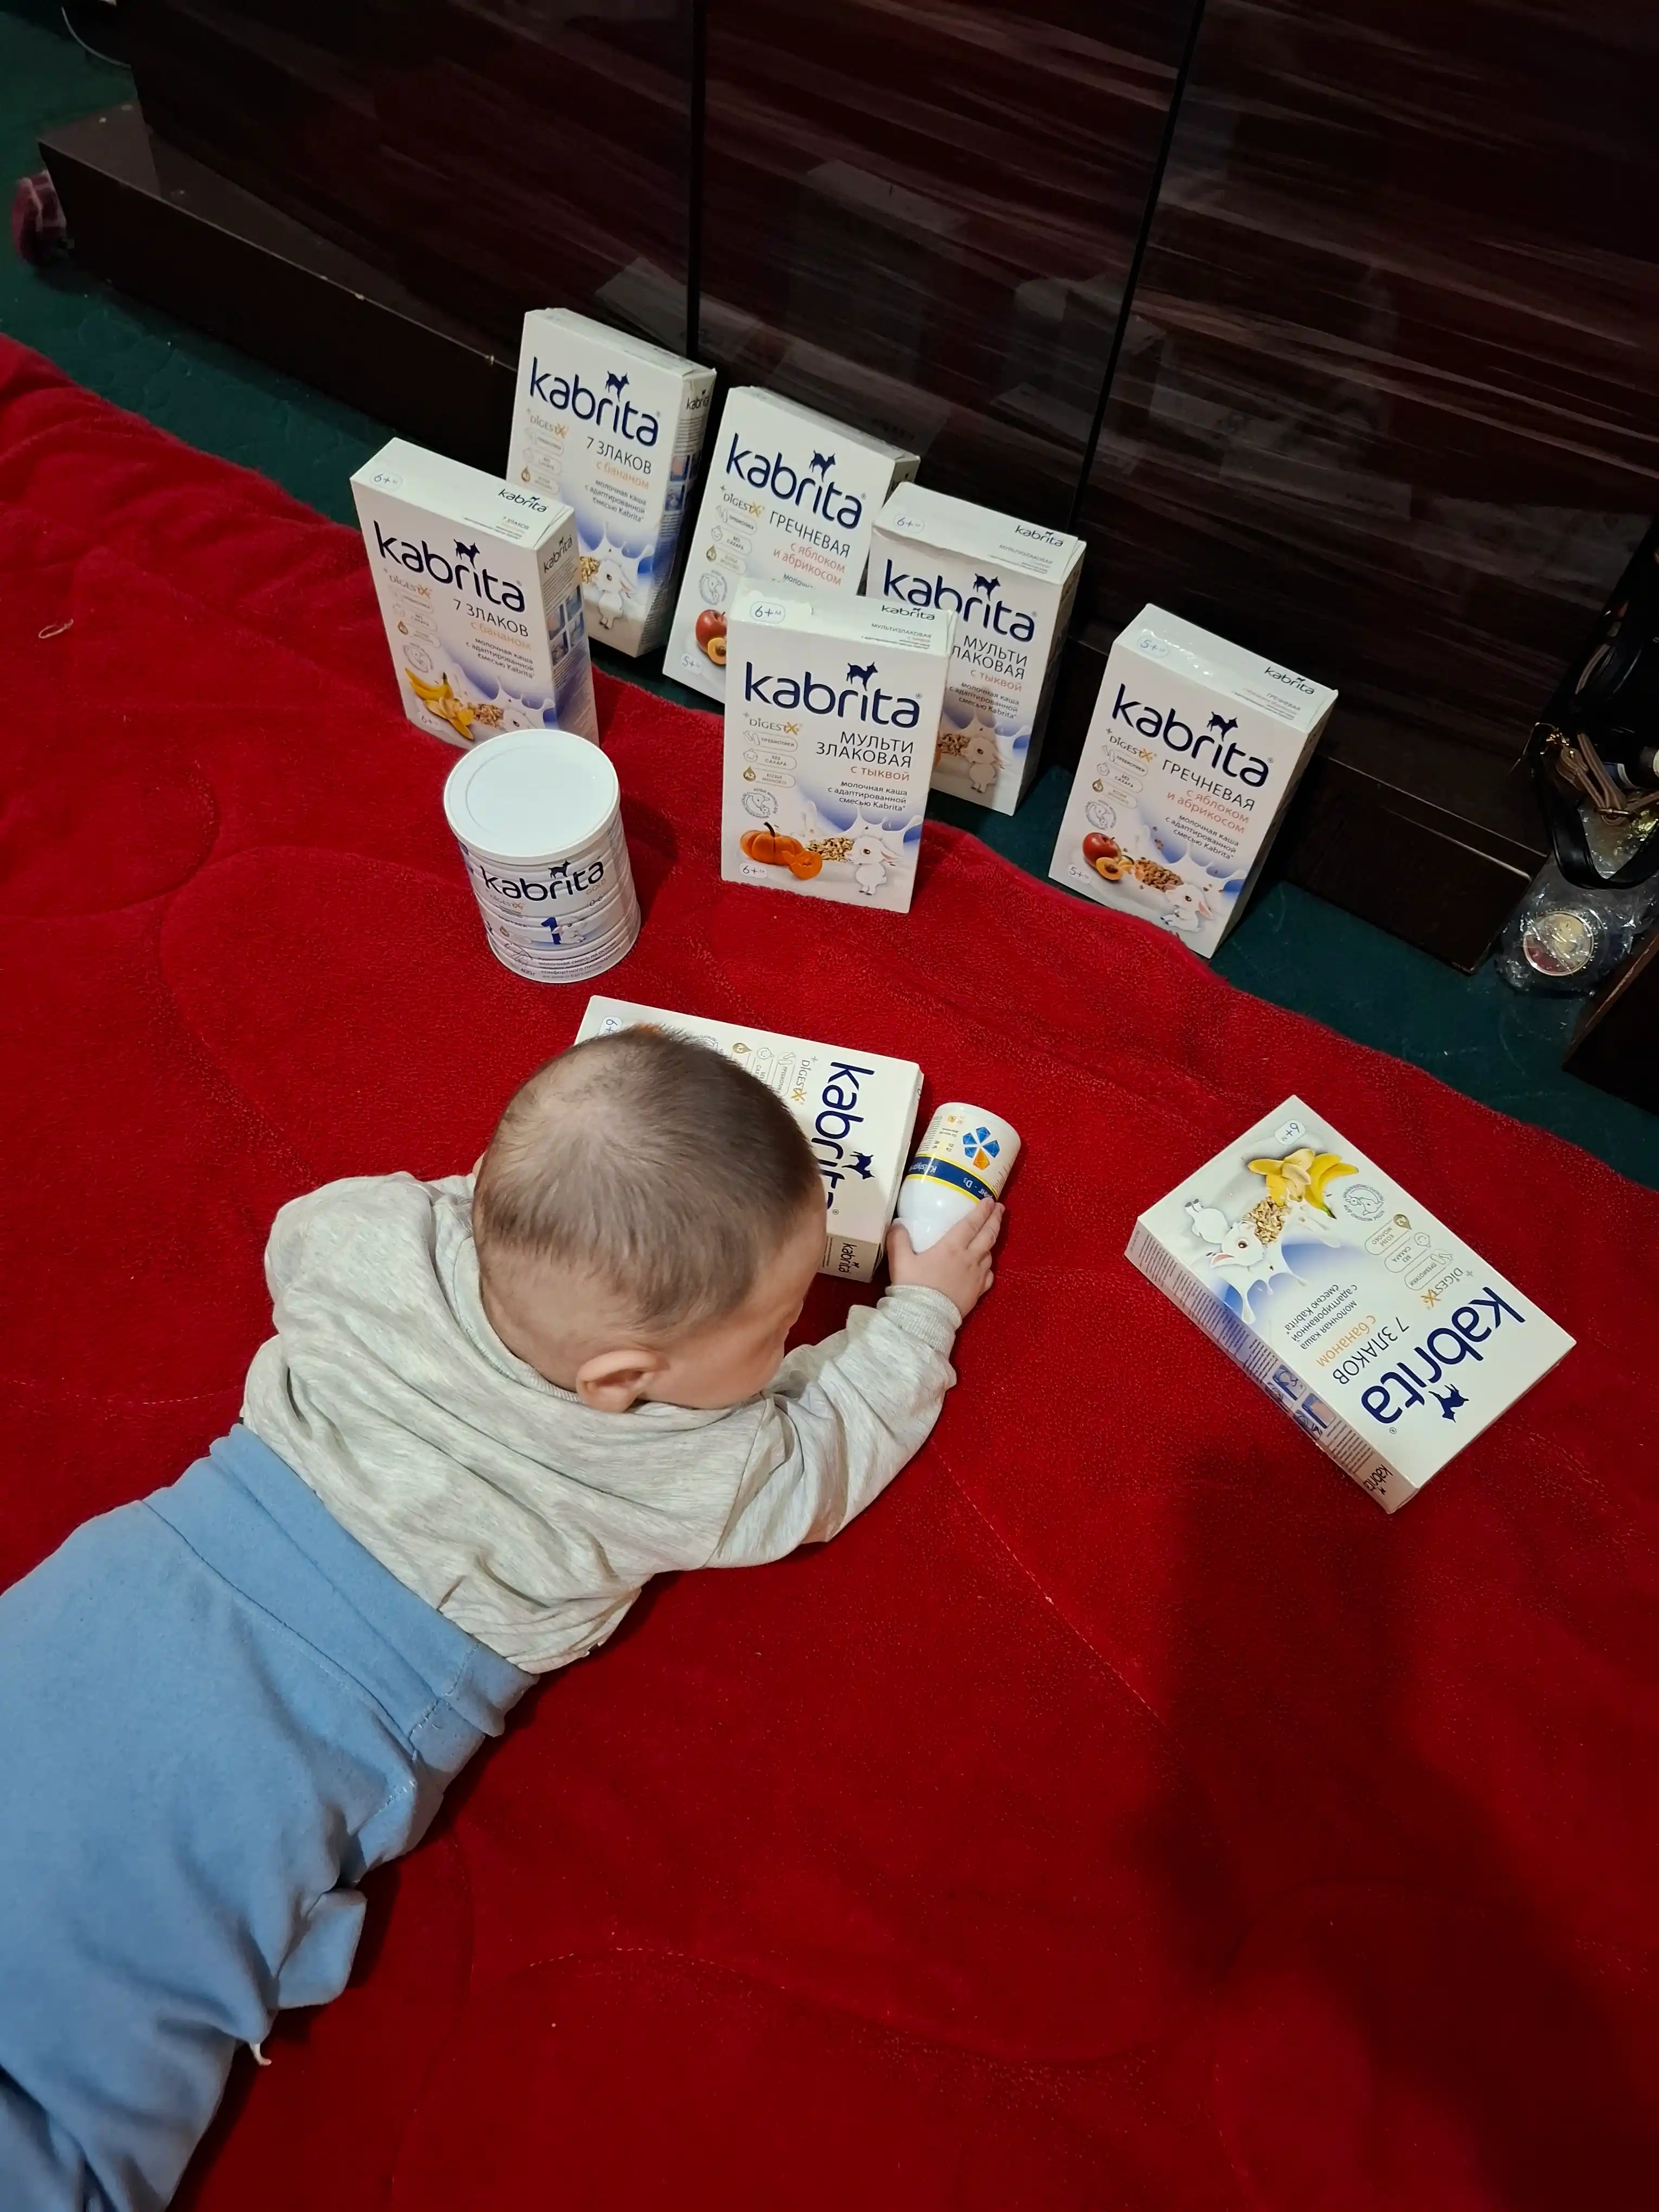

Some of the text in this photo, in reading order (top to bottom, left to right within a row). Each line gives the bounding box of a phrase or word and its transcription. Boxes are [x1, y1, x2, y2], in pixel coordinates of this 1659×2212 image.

[530, 356, 658, 446] kabrita
[587, 436, 594, 449] 7
[596, 441, 652, 474] ЗЛАКОВ
[604, 461, 650, 489] бананом
[726, 433, 862, 529] kabrita
[498, 488, 548, 513] kabrita
[769, 511, 851, 558] ГРЕЧНЕВАЯ
[1015, 525, 1063, 546] kabrita
[374, 520, 525, 613] kabrita
[543, 537, 573, 573] kabrita
[773, 549, 842, 587] и абрикосом
[798, 544, 846, 574] яблоком
[882, 605, 935, 621] kabrita
[884, 558, 1035, 642] kabrita
[453, 599, 461, 610] 7
[466, 603, 529, 637] ЗЛАКОВ
[480, 623, 531, 651] бананом
[963, 635, 1027, 667] МУЛЬТИ
[952, 645, 1025, 680] ЛАКОВАЯ
[745, 661, 920, 728] kabrita
[1264, 666, 1315, 695] kabrita
[840, 731, 914, 754] МУЛЬТИ
[1112, 683, 1269, 787] kabrita
[815, 742, 912, 768] ЗЛАКОВАЯ
[840, 781, 908, 796] молочная каша
[860, 767, 910, 781] тыквой
[1162, 759, 1256, 812] ГРЕЧНЕВАЯ
[834, 788, 906, 804] адаптированной
[839, 797, 871, 807] смесью
[1195, 794, 1250, 824] яблоком
[1167, 792, 1245, 834] и абрикосом
[1171, 820, 1237, 853] адаптированной
[1173, 829, 1203, 846] смесью
[1179, 815, 1239, 846] молочная каша
[480, 861, 604, 901] kabrita
[541, 917, 562, 945] 1
[811, 1062, 875, 1210] kabrit
[838, 1243, 857, 1274] kabrita
[1391, 1246, 1411, 1262] САХАРА
[1410, 1262, 1437, 1287] ПРЕБИОТИКИ
[1311, 1284, 1339, 1309] смесью
[1291, 1288, 1353, 1343] адаптированной
[1300, 1300, 1358, 1350] молочная каша
[1316, 1322, 1370, 1367] бананом
[1333, 1317, 1410, 1385] 7 ЗЛАКОВ
[1361, 1287, 1526, 1424] kabrita
[1362, 1464, 1393, 1491] kabrita
